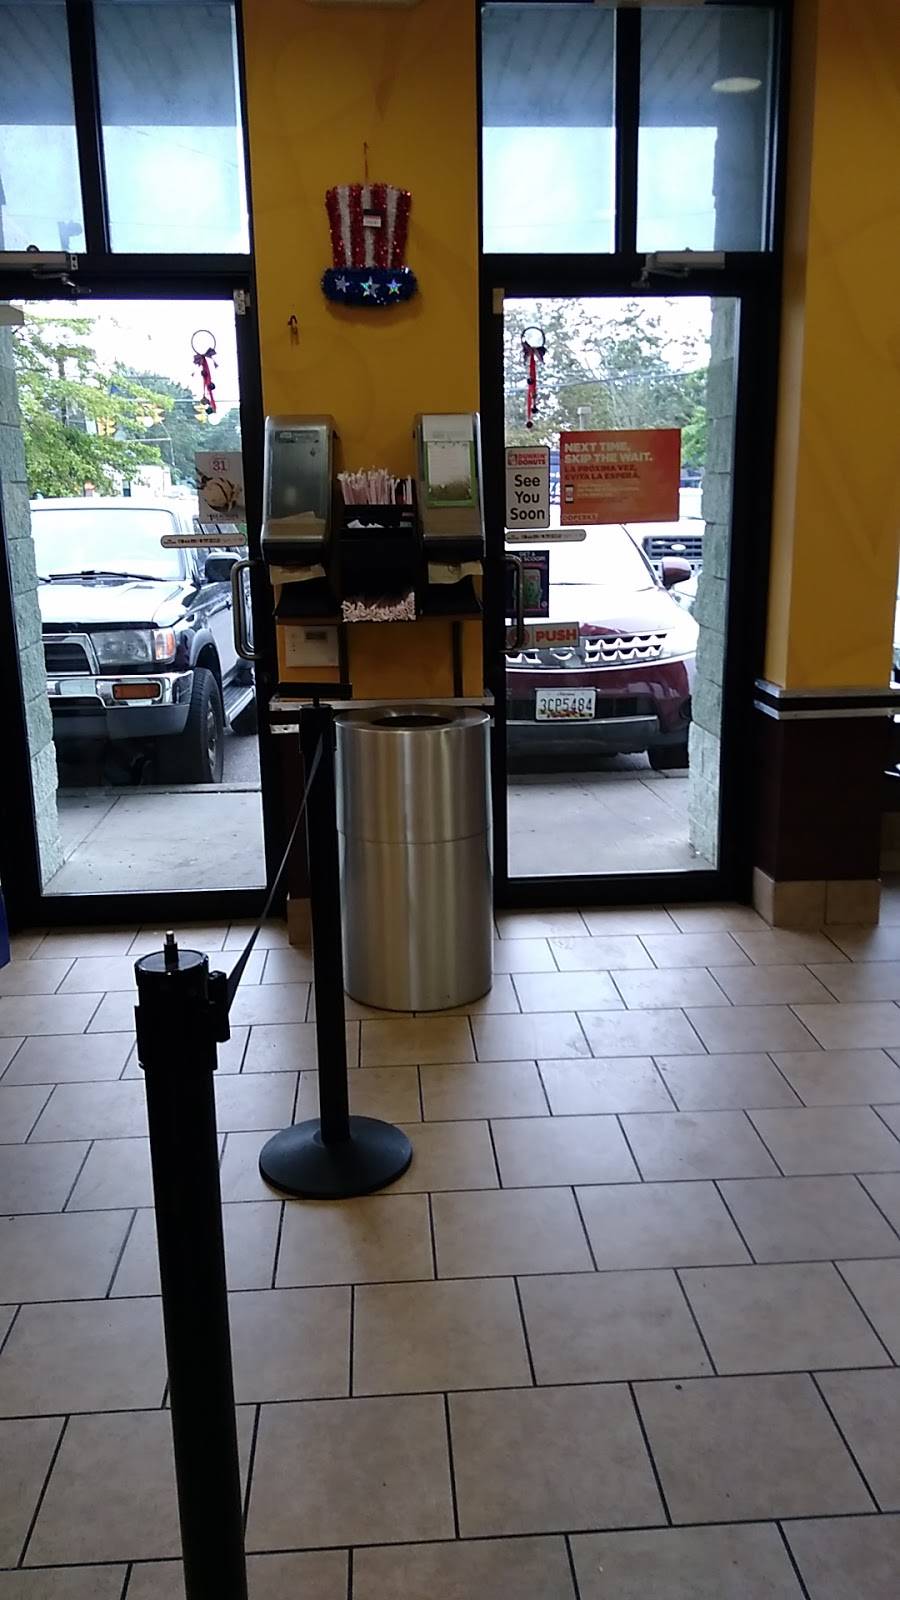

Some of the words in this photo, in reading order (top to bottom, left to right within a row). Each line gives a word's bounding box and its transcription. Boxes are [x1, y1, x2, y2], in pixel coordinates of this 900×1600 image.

[564, 442, 596, 452] NEXT
[564, 453, 592, 464] SKIP
[594, 453, 617, 463] THE
[619, 451, 653, 462] WAIT.
[514, 474, 541, 487] See
[514, 491, 540, 503] You
[510, 507, 545, 520] Soon
[535, 629, 577, 643] PUSH
